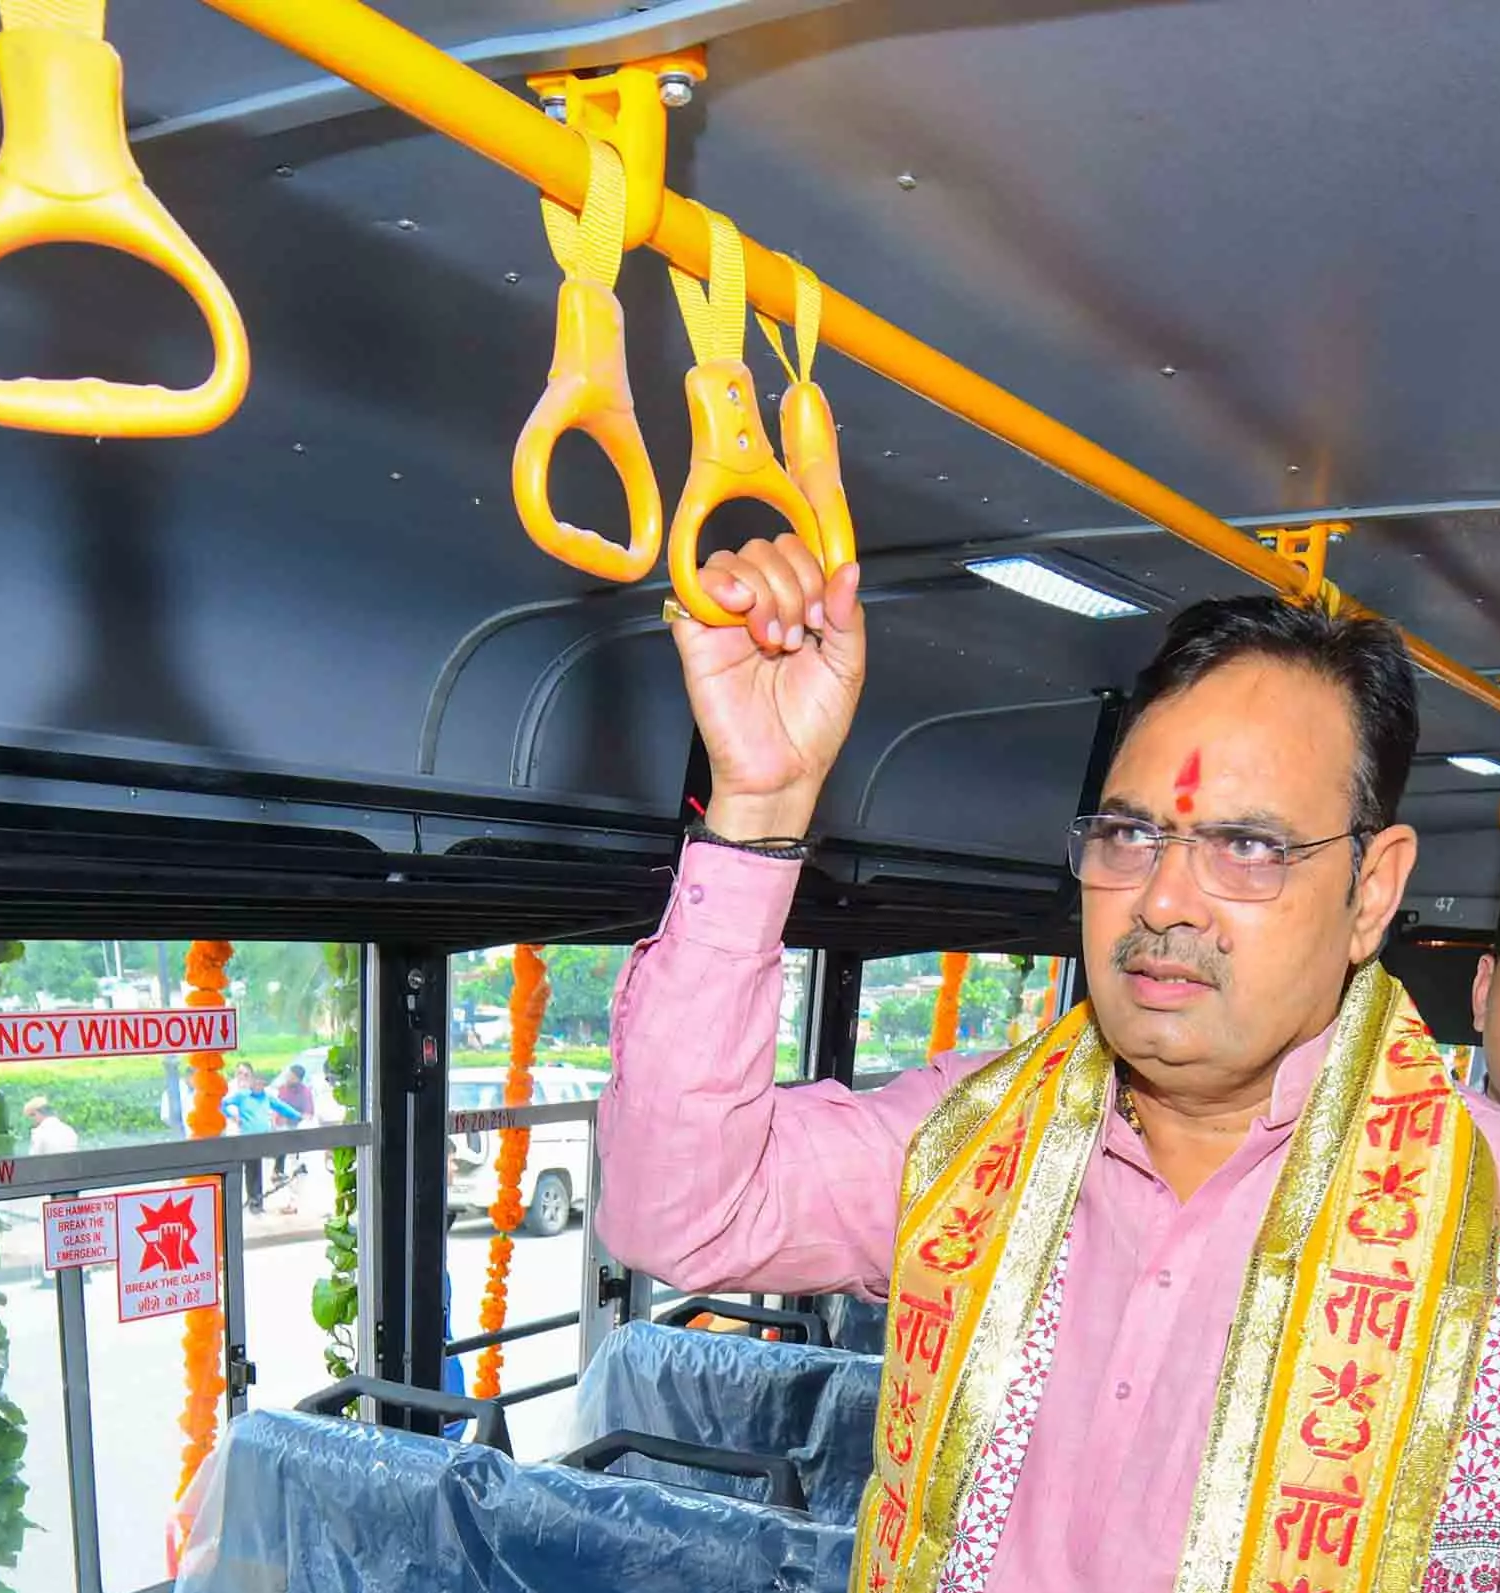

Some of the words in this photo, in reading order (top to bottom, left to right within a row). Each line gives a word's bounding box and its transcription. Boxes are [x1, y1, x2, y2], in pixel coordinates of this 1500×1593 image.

[1435, 897, 1454, 912] 47
[78, 1016, 214, 1050] WINDOW
[46, 1207, 64, 1218] USE
[66, 1203, 102, 1215] HAMMER
[103, 1201, 115, 1212] TO
[58, 1221, 86, 1232] BREAK
[88, 1217, 104, 1228] THE
[63, 1234, 91, 1246] GLASS
[93, 1232, 101, 1242] IN
[57, 1248, 108, 1262] EMERGENCY
[125, 1280, 158, 1295] BREAK
[160, 1277, 179, 1288] THE
[181, 1271, 212, 1284] GLASS
[165, 1292, 178, 1306] को
